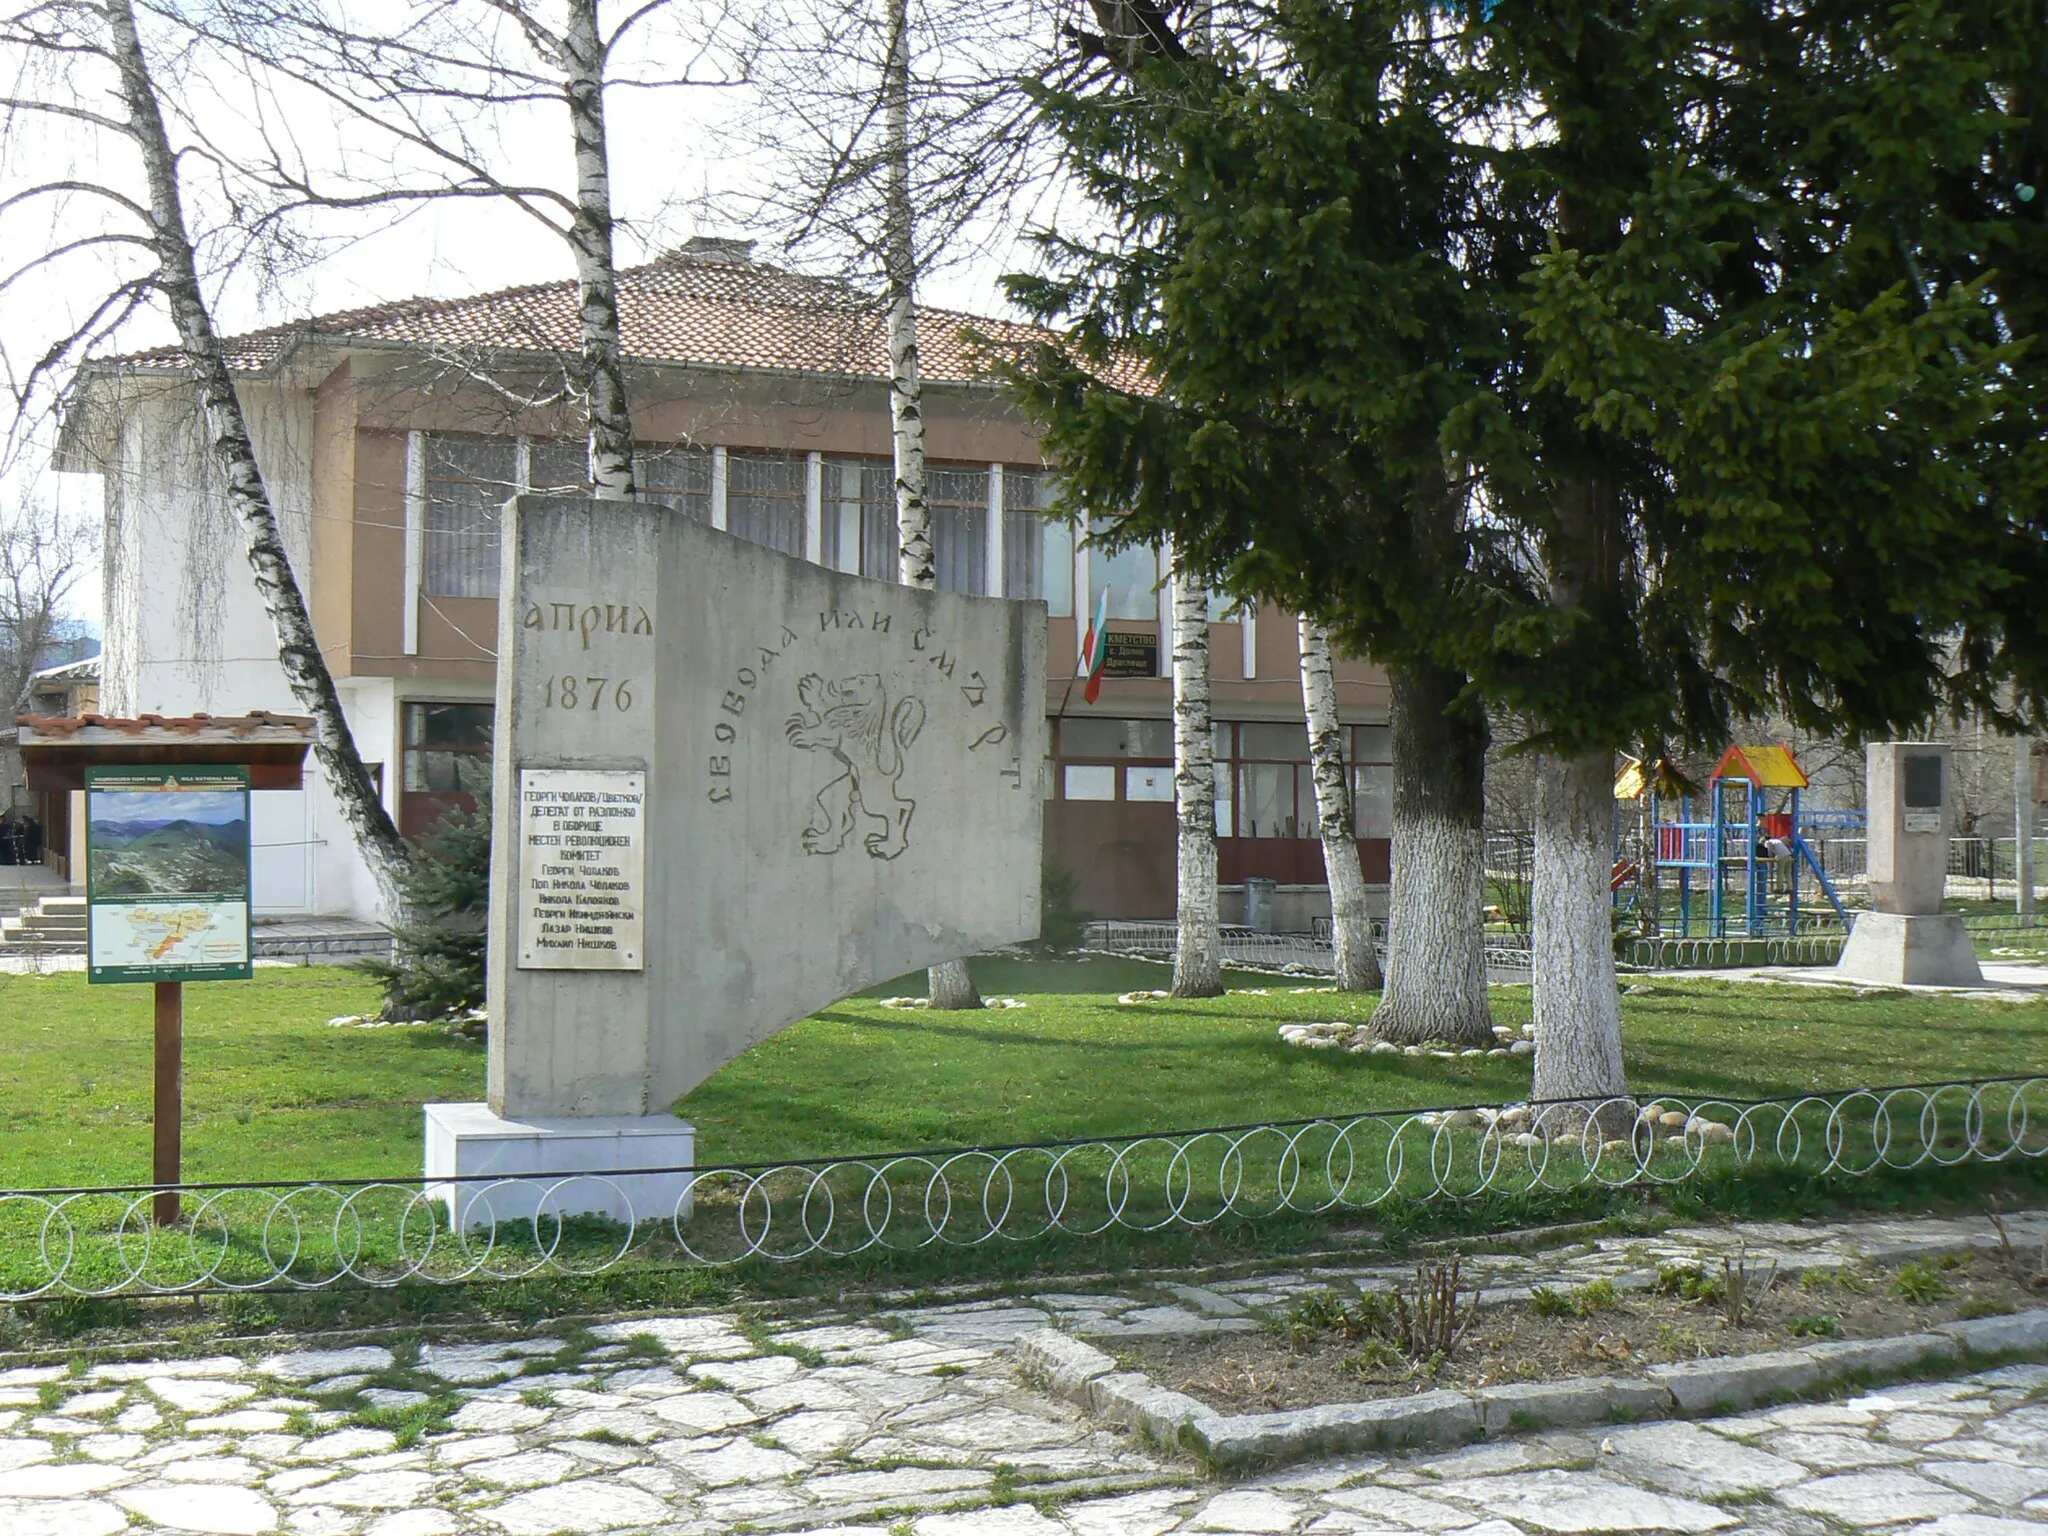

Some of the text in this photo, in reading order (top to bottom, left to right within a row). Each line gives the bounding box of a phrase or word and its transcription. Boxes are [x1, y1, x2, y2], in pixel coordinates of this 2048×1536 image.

[1108, 634, 1155, 645] КМЕТСТВО
[545, 675, 632, 712] 1876
[524, 791, 557, 802] ГЕОРГИ
[530, 806, 636, 817] ДЕЛЕГАТ ОТ РАЗЛОЖКО
[553, 820, 603, 833] В ОБОРИЩЕ
[528, 835, 630, 847] МЕСТЕН РЕВОЛЮЦИОНЕН
[560, 850, 603, 861] КОМИТЕТ
